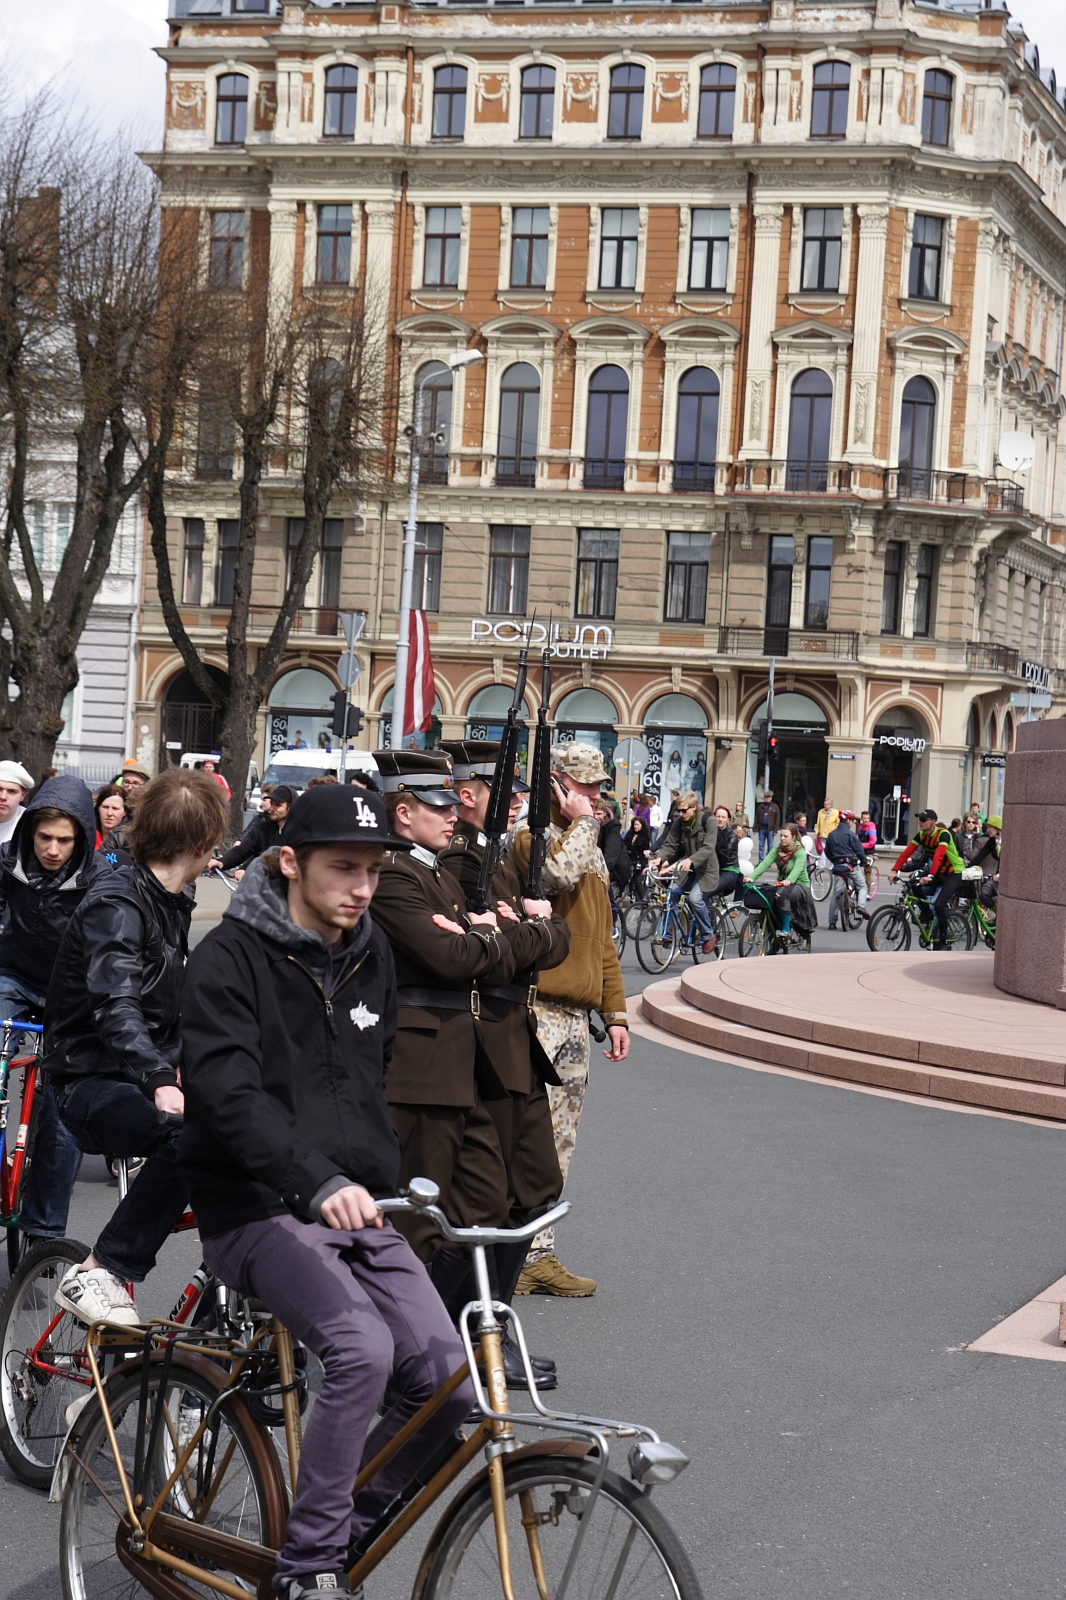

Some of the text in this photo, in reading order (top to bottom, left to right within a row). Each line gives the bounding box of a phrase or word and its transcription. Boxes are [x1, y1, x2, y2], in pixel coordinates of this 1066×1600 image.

[471, 620, 612, 646] PODIUM
[541, 645, 610, 659] OUTLET
[273, 718, 286, 730] 60
[472, 728, 485, 740] 60
[648, 737, 662, 749] 60
[880, 736, 925, 748] PODIUM
[643, 771, 662, 787] 60
[353, 797, 378, 828] LA
